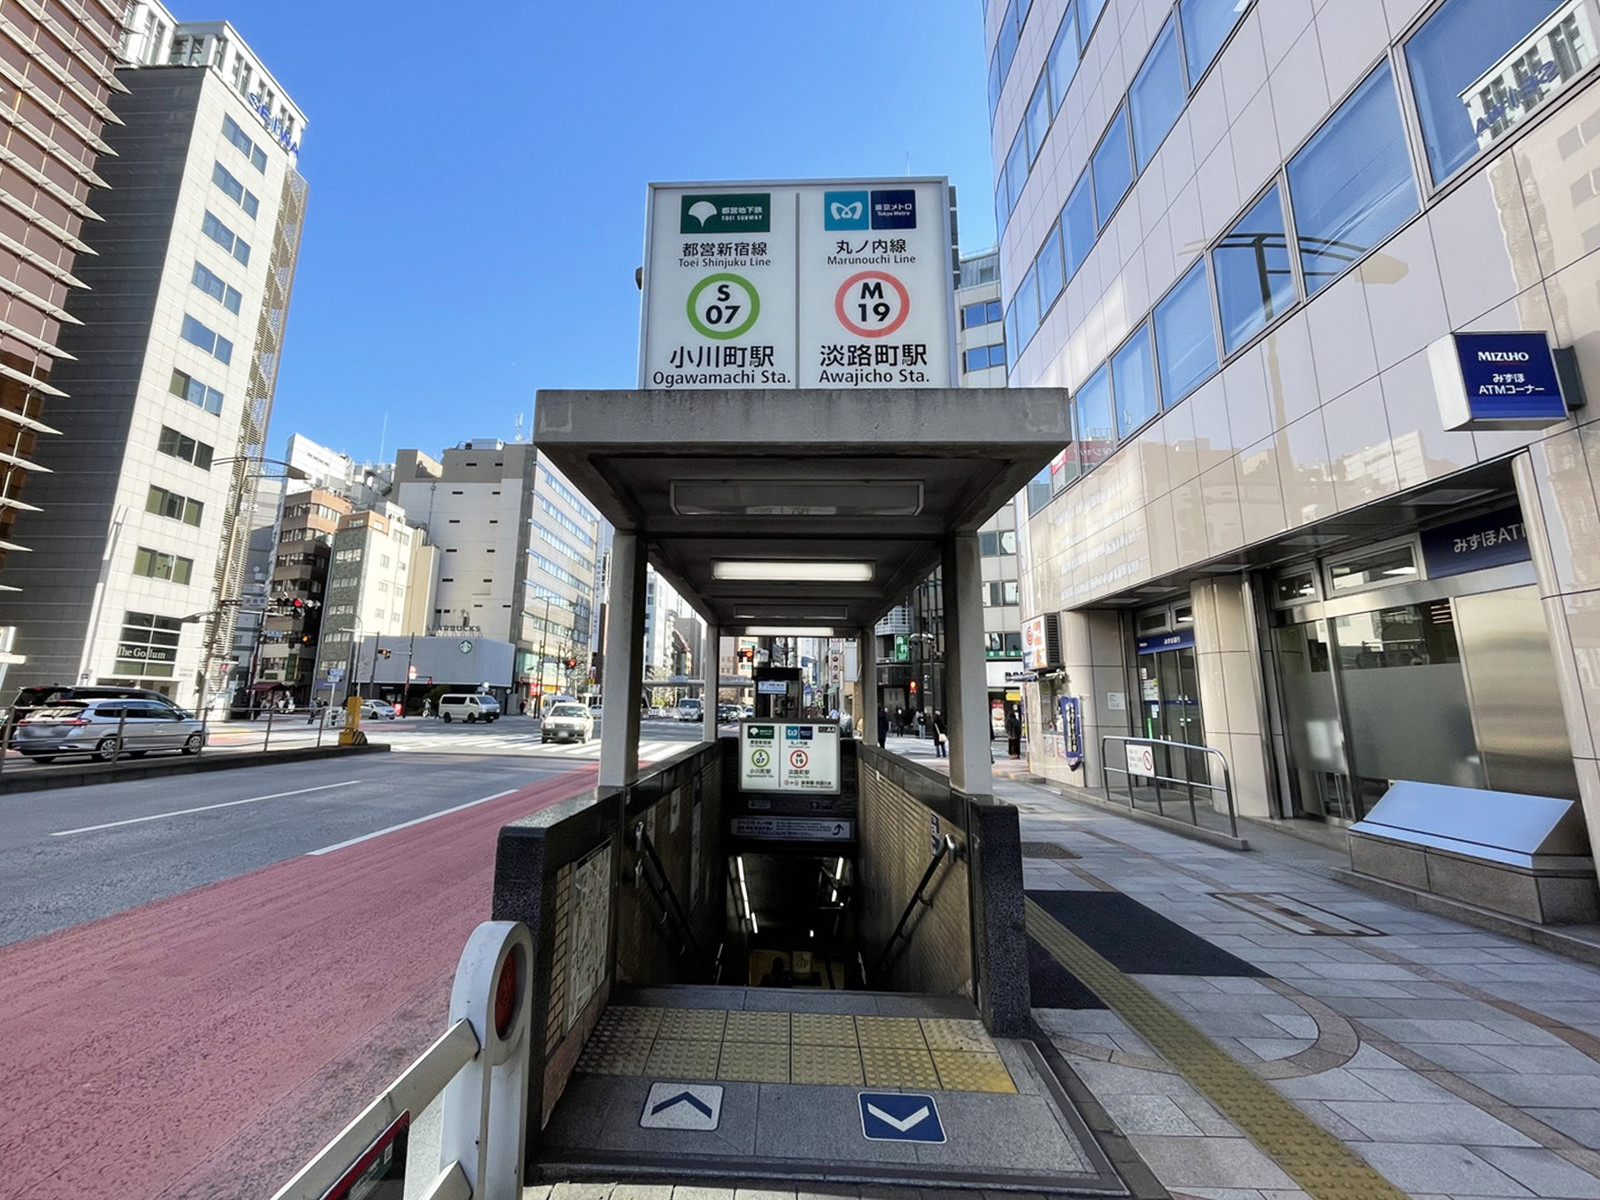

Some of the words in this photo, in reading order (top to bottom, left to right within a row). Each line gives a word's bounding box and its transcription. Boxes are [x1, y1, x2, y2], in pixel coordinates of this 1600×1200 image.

[721, 206, 763, 215] 都営地下鉄
[874, 203, 912, 211] 東京メトロ
[682, 241, 768, 257] 都営新宿線
[836, 238, 907, 254] 丸ノ内線
[678, 257, 699, 268] Toei
[702, 257, 747, 269] Shinjuku
[749, 256, 772, 267] Line
[827, 255, 891, 265] Marunouchi
[893, 254, 916, 264] Line
[716, 284, 731, 302] S
[859, 282, 884, 300] M
[705, 305, 741, 325] 07
[857, 302, 891, 323] 19
[669, 345, 775, 368] 小川町駅
[819, 344, 928, 367] 淡路町駅
[1477, 351, 1530, 362] MIZUHO
[652, 369, 755, 388] Ogawamachi
[760, 369, 791, 384] Sta.
[818, 368, 893, 386] Awajicho
[898, 368, 930, 383] Sta.
[1492, 373, 1526, 383] みずほ
[1478, 384, 1545, 395] ATMコーナー
[117, 646, 133, 657] The
